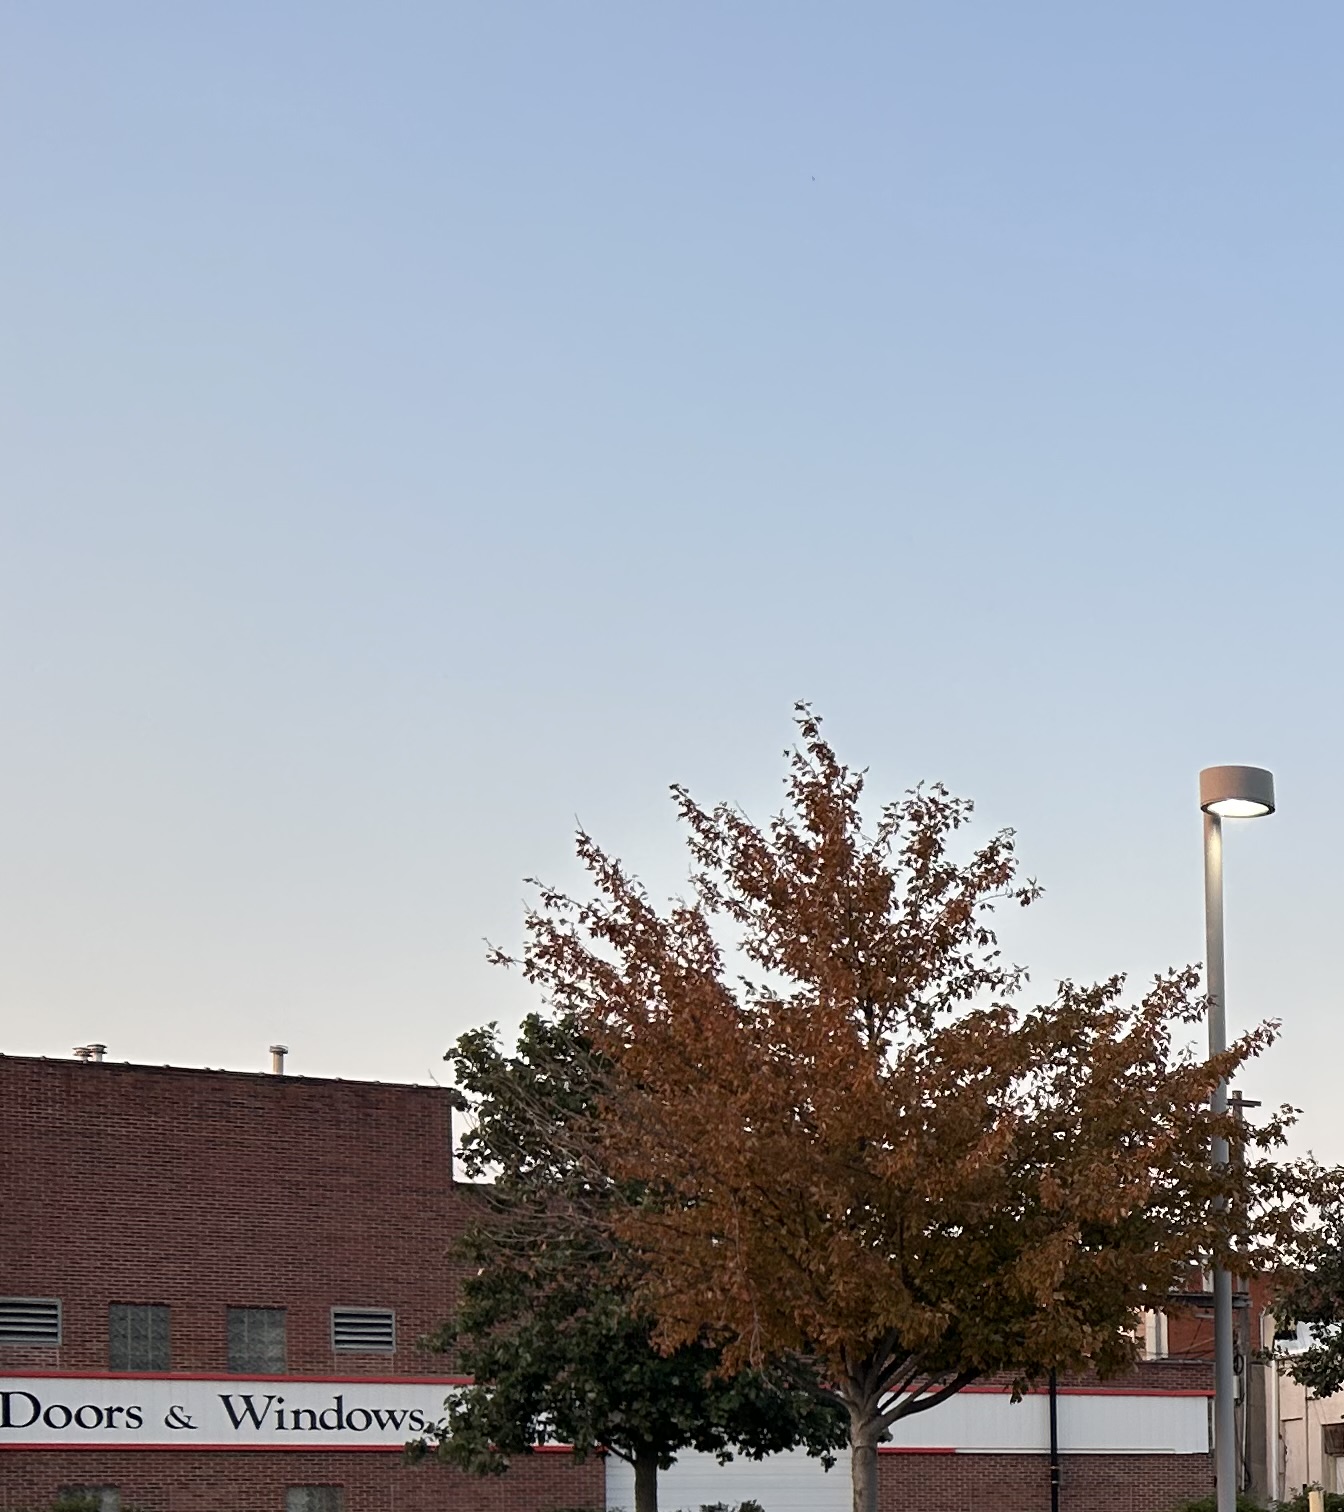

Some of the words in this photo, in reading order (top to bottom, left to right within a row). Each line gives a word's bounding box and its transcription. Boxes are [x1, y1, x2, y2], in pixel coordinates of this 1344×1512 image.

[0, 1390, 143, 1430] Doors
[164, 1404, 199, 1430] &
[217, 1394, 425, 1432] Windows
